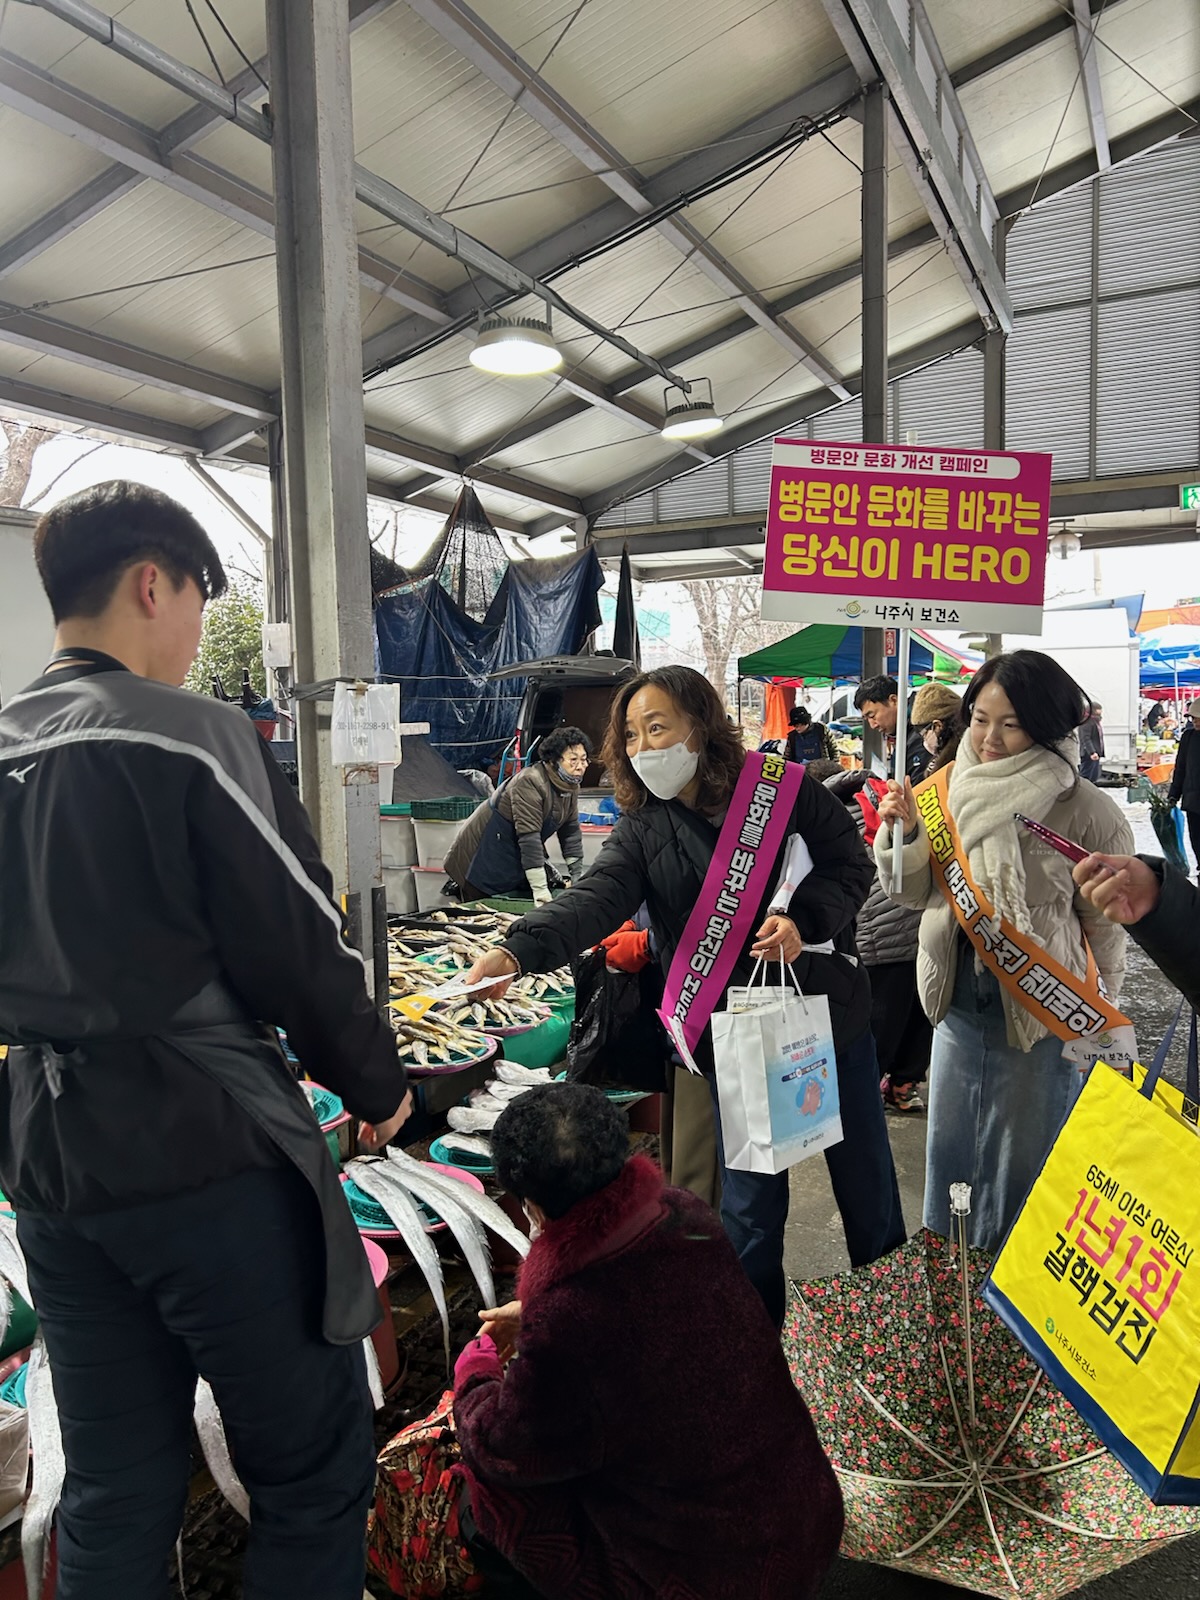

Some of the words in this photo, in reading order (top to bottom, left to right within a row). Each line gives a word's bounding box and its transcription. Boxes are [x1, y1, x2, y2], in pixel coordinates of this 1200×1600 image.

[810, 448, 859, 467] 병문안
[863, 452, 897, 469] 문화
[901, 454, 934, 471] 개선
[939, 456, 988, 474] 캠페인
[777, 479, 861, 526] 병문안
[866, 484, 949, 531] 문화를
[957, 490, 1041, 536] 바꾸는
[782, 533, 900, 581] 당신이
[912, 541, 1031, 585] HERO
[875, 605, 914, 621] 나주시
[920, 607, 960, 623] 보건소
[739, 782, 778, 849] 문화를
[715, 847, 756, 916] 바꾸는
[916, 784, 955, 863] 병문안
[943, 858, 980, 920] 문화
[973, 915, 1030, 975] 개선
[1017, 963, 1107, 1037] 캠페인
[689, 914, 732, 977] 당신이
[1086, 1164, 1120, 1202] 65세
[1117, 1191, 1151, 1228] 이상
[1150, 1218, 1194, 1269] 어르신
[1055, 1329, 1097, 1381] 나주시보건소
